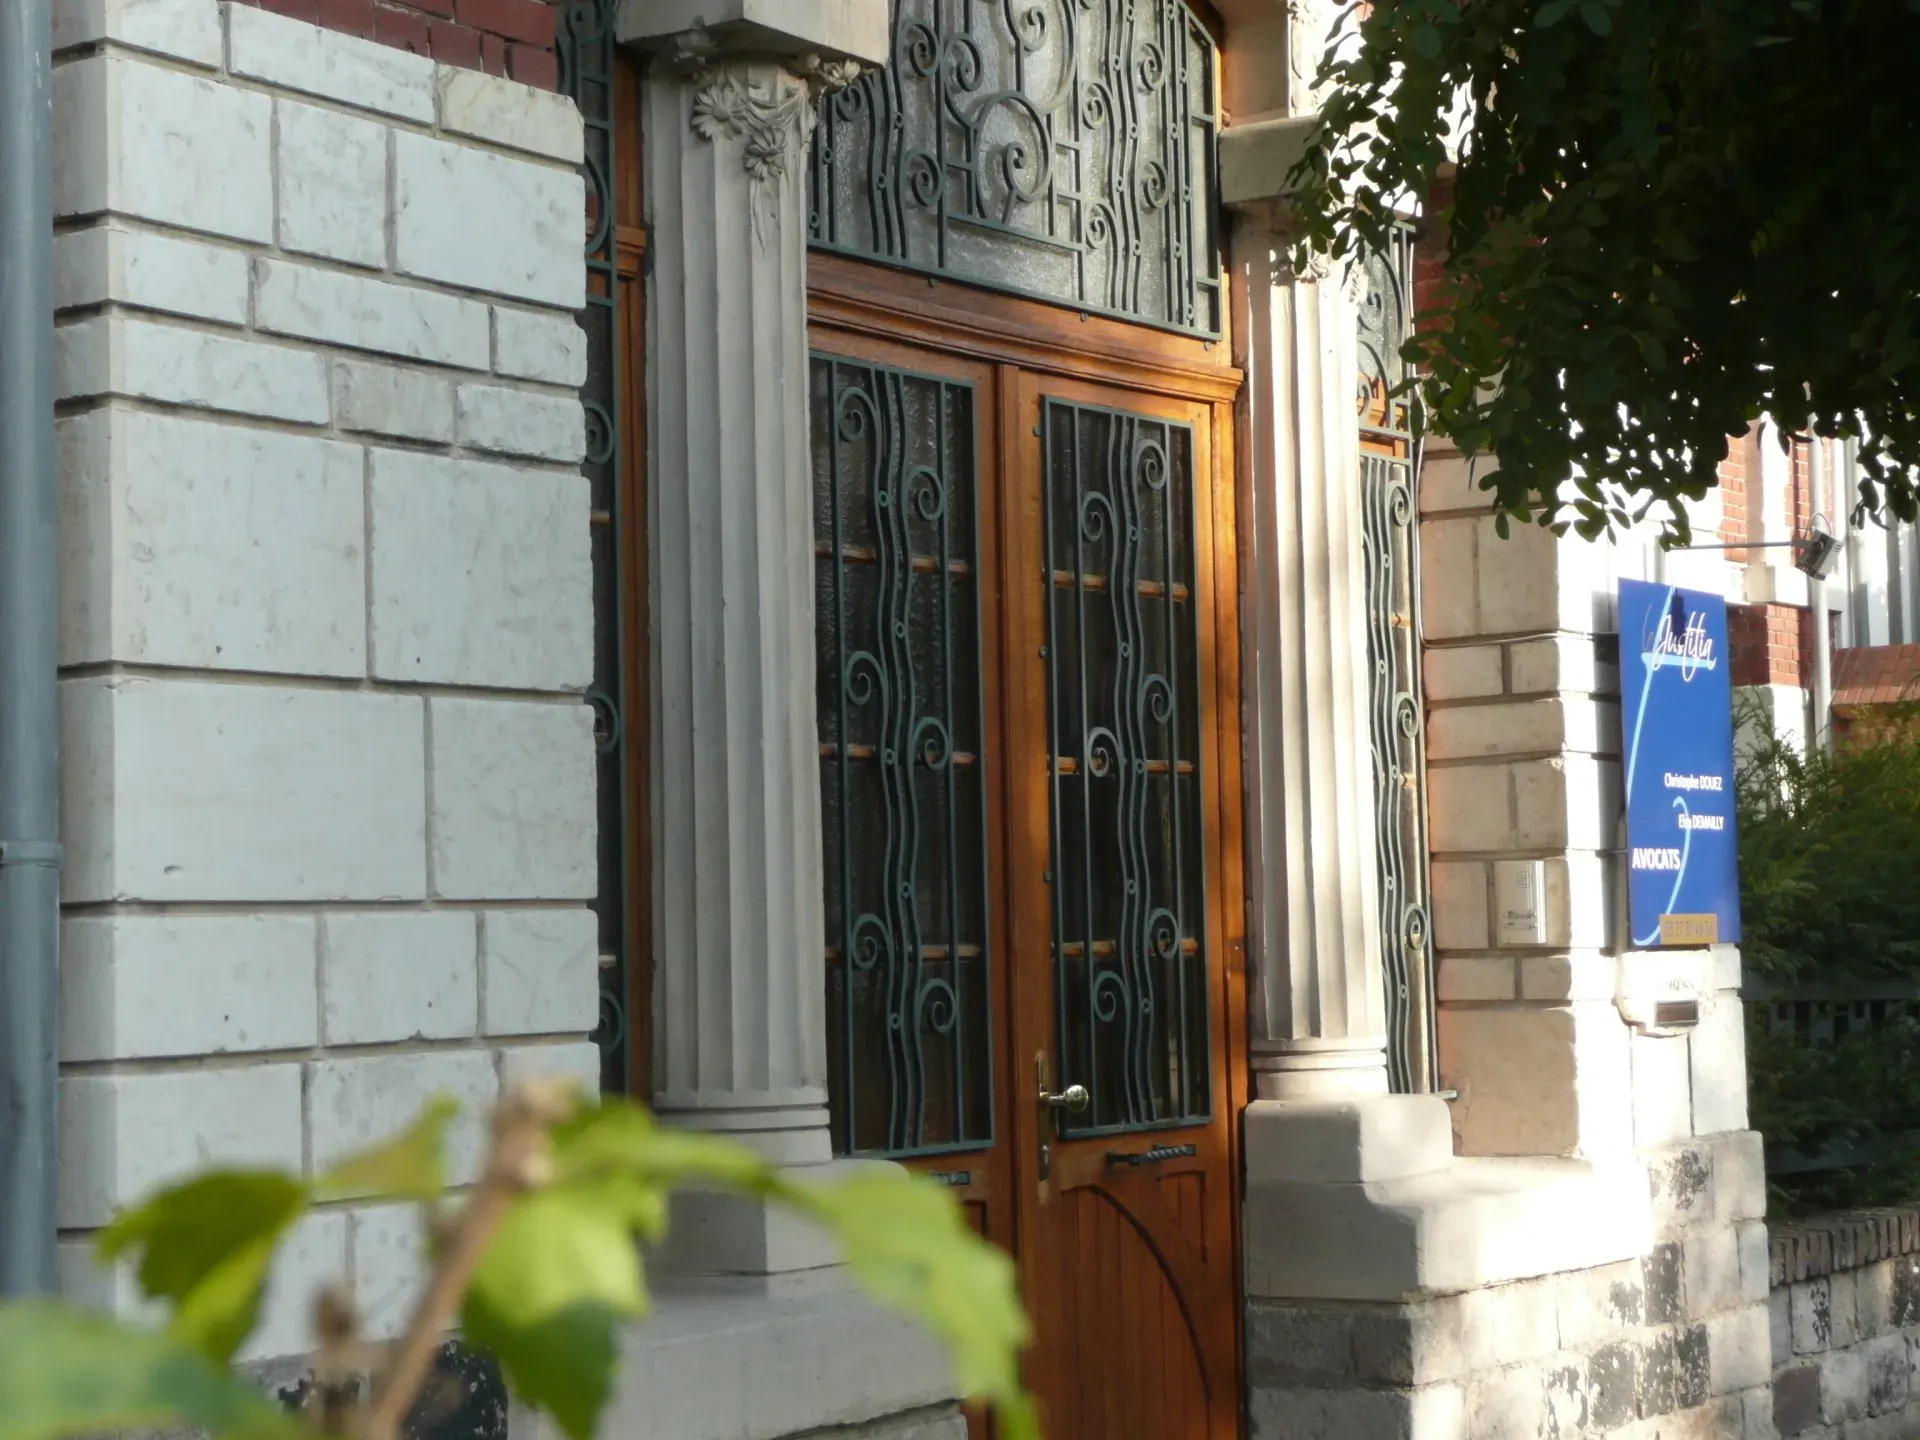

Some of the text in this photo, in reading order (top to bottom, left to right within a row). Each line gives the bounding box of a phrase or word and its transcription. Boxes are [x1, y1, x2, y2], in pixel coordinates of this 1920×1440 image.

[1664, 772, 1723, 792] Christophe DOUEZ
[1632, 847, 1681, 871] AVOCATS
